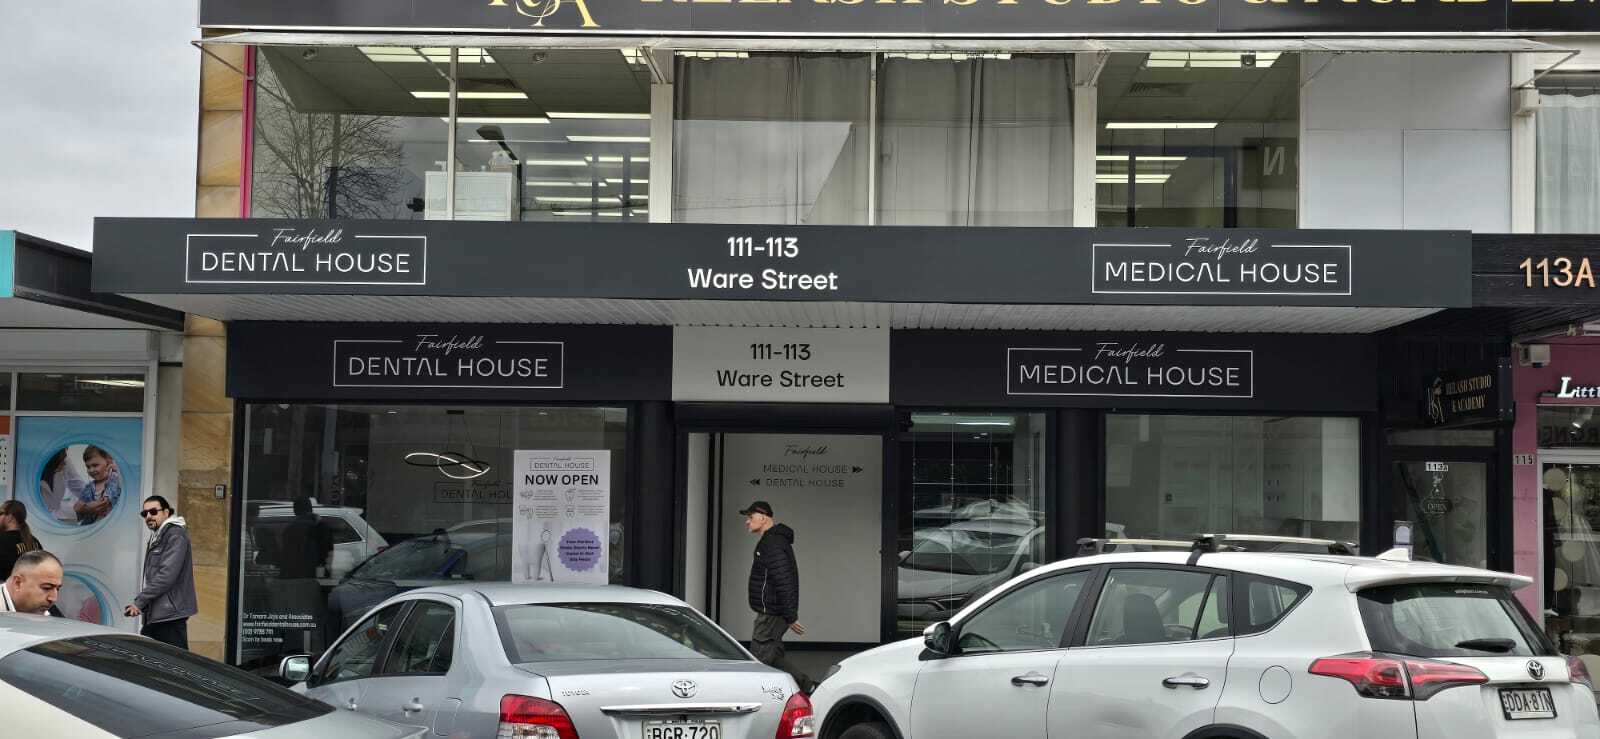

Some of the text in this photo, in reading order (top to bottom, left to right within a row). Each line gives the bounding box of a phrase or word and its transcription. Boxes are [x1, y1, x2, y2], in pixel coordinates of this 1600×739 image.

[270, 228, 344, 251] Fairfield
[727, 236, 799, 258] 111-113
[1184, 238, 1259, 261] Fairfield
[201, 252, 411, 273] DENTAL HOUSE
[1105, 261, 1338, 283] MEDICAL HOUSE
[1519, 257, 1596, 288] 113A
[687, 268, 839, 290] Ware Street
[415, 334, 484, 356] Fairfield
[750, 343, 812, 361] 111-113
[1095, 342, 1165, 364] Fairfield
[349, 356, 548, 378] DENTAL HOUSE
[1019, 364, 1241, 387] MEDICAL HOUSE
[716, 369, 845, 388] Ware Street
[763, 463, 848, 474] MEDICAL HOUSE
[1515, 455, 1533, 465] 115
[525, 474, 599, 486] NOW OPEN
[766, 478, 845, 488] DENTAL HOUSE
